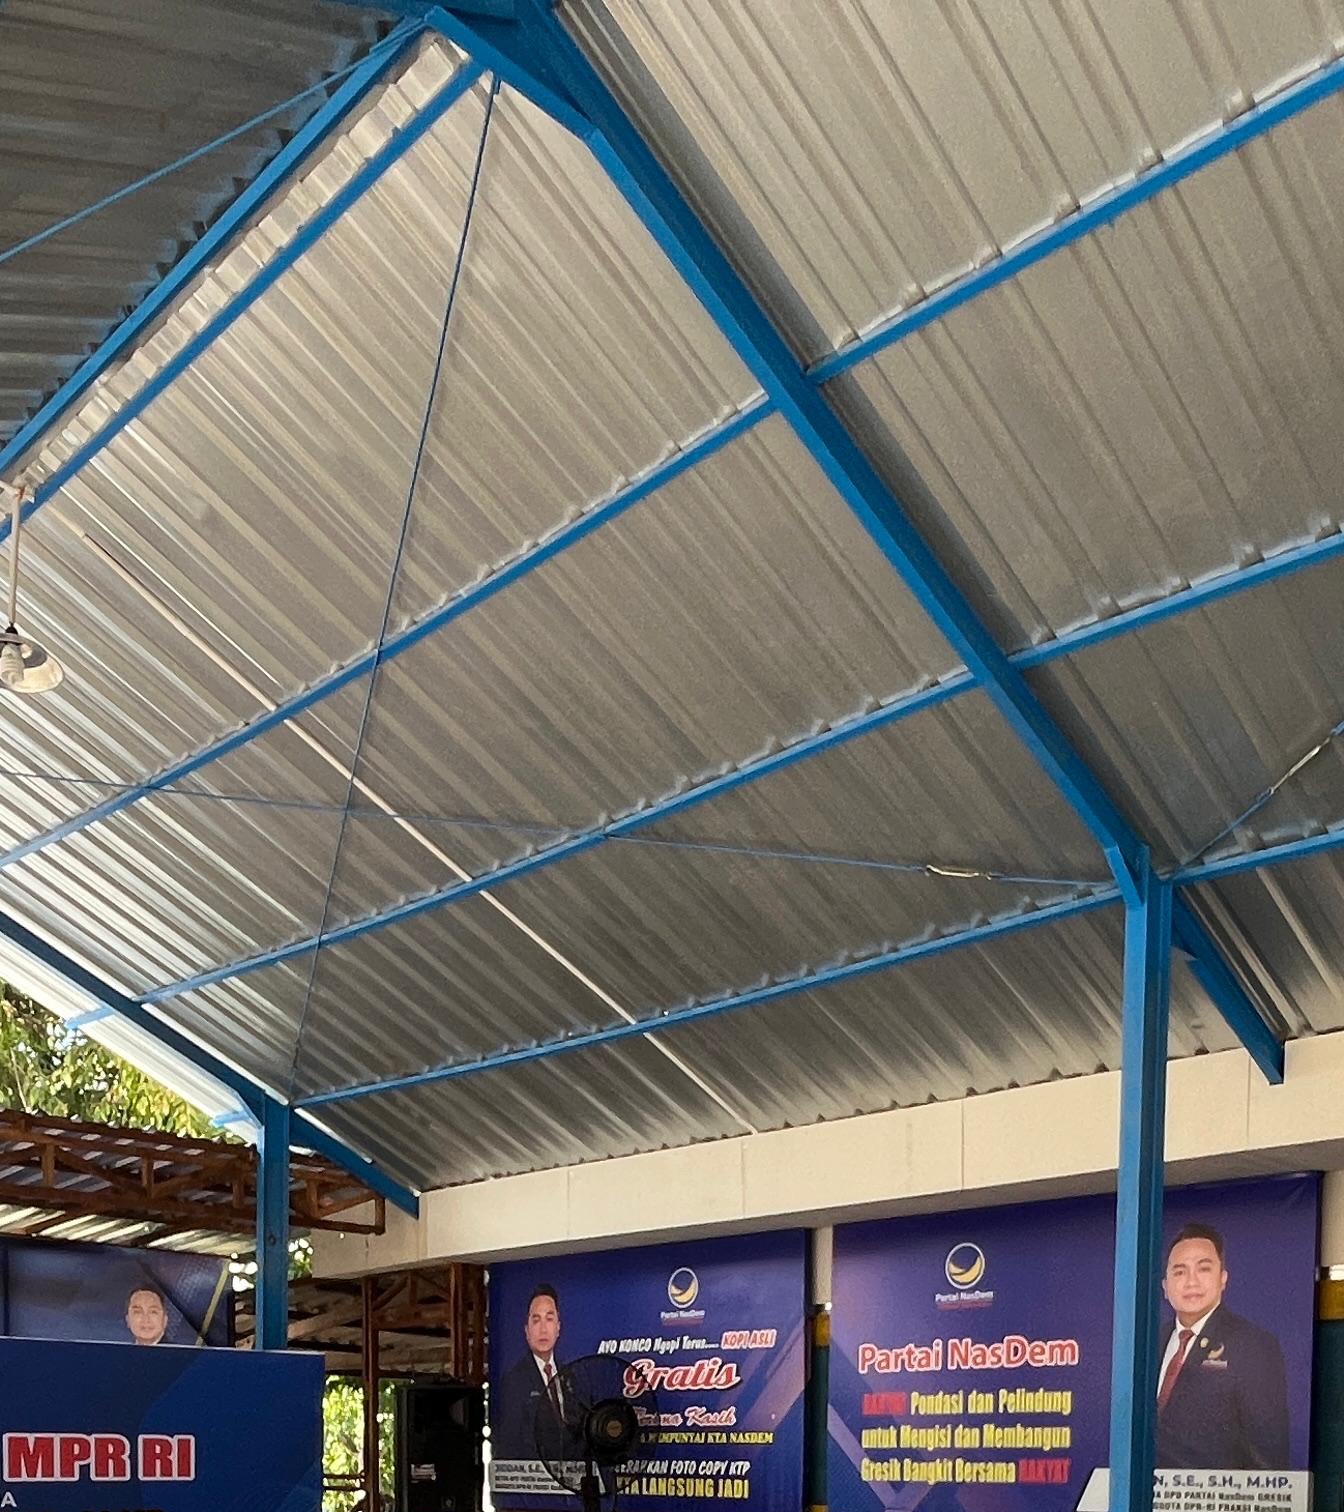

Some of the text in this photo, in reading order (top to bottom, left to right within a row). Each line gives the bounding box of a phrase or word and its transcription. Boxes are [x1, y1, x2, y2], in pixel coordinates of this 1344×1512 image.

[721, 1330, 749, 1349] KOPI
[749, 1328, 777, 1348] ASLI
[858, 1335, 1079, 1374] Partai NasDem
[623, 1356, 742, 1399] Gratis
[910, 1390, 964, 1416] Pondasi
[967, 1388, 994, 1414] dan
[998, 1387, 1072, 1416] Pelindung
[861, 1422, 1071, 1451] untuk Mengisi dan Membangun
[2, 1432, 131, 1482] MPR
[138, 1434, 196, 1482] RI
[670, 1460, 697, 1475] FOTO
[698, 1460, 729, 1475] COPY
[729, 1461, 752, 1476] KTP
[903, 1457, 953, 1485] Bangkit
[955, 1457, 1017, 1484] Bersama
[642, 1478, 715, 1498] LANGSUNG
[717, 1479, 749, 1499] JADI
